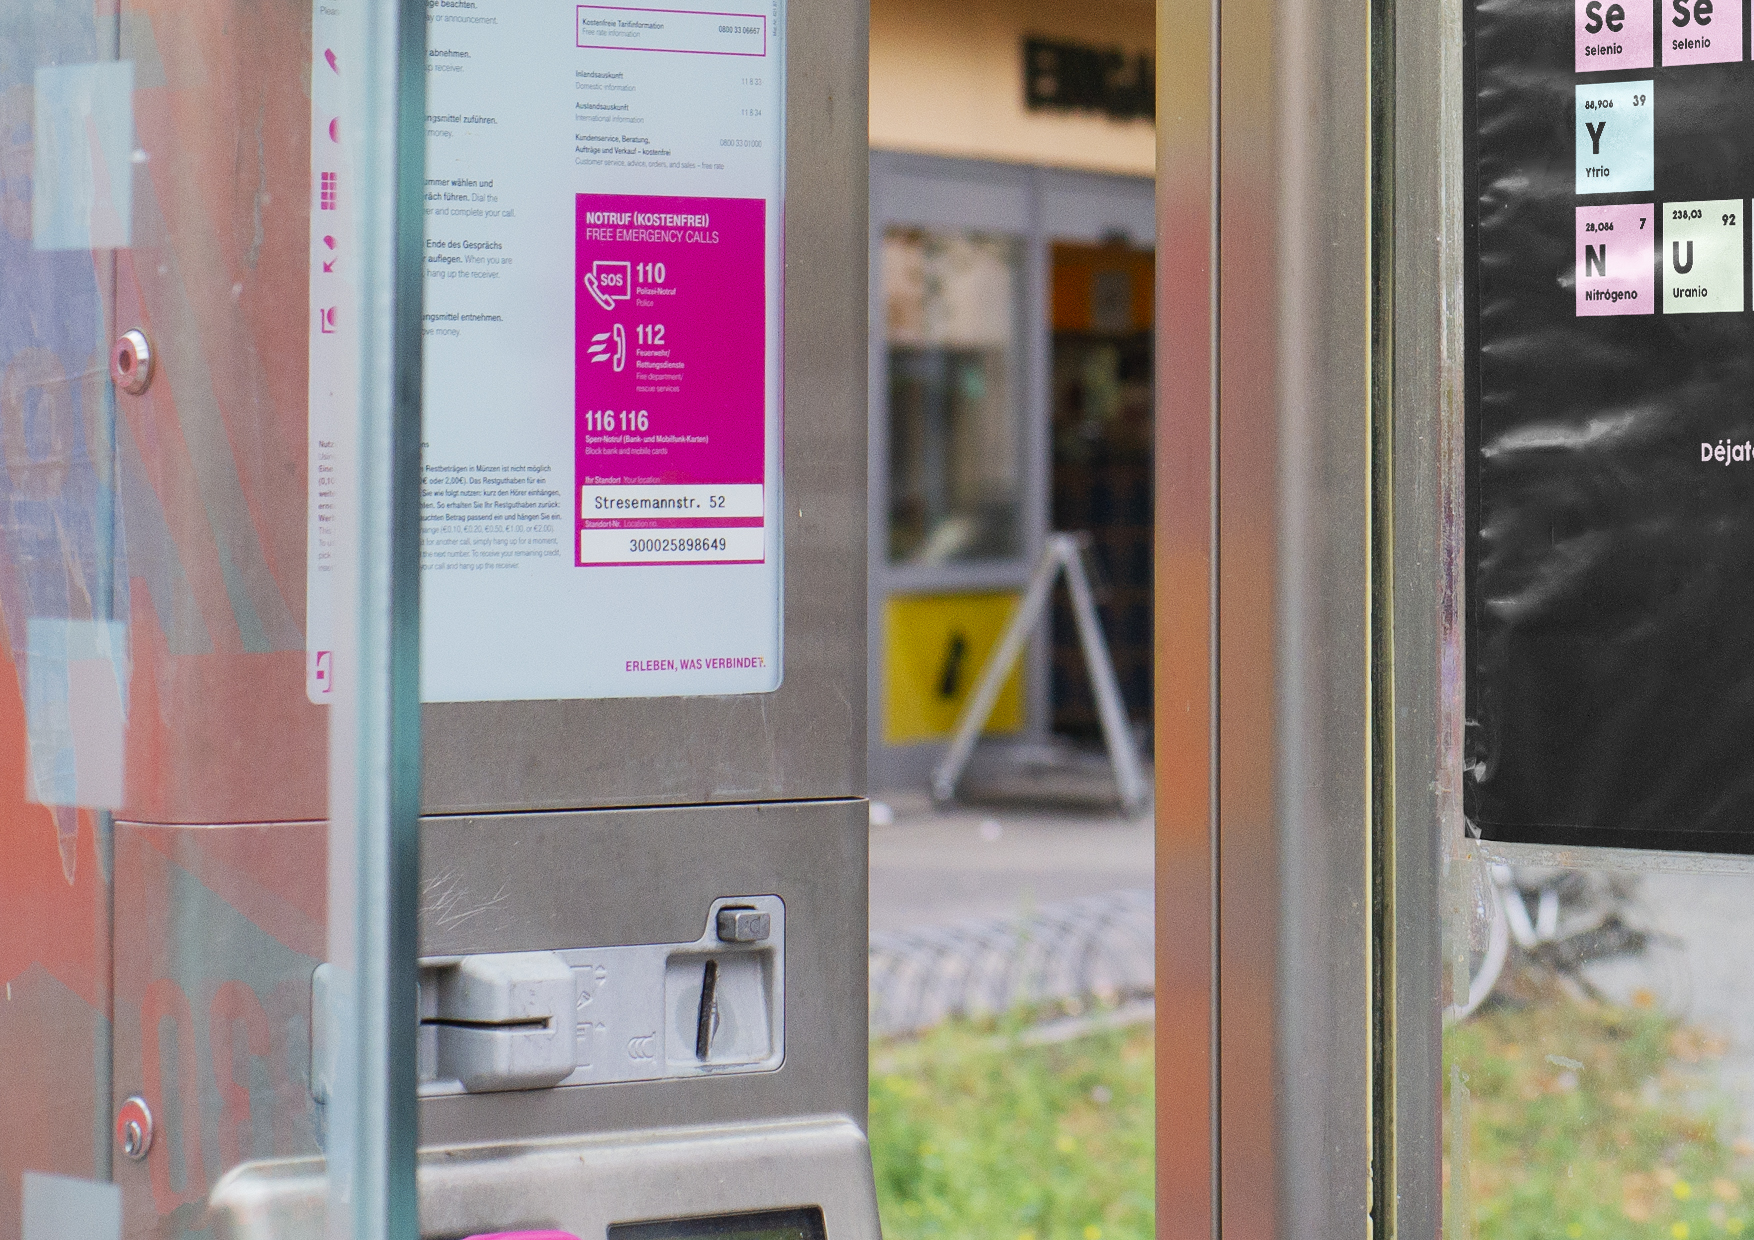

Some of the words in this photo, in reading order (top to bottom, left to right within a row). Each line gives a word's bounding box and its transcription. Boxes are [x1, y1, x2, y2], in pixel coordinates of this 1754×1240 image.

[441, 0, 478, 9] beachten.
[1585, 1, 1625, 34] Se
[583, 19, 616, 27] Kostenfreie
[617, 20, 664, 30] Tarifinformation
[1673, 36, 1710, 50] Selenio
[429, 49, 471, 58] abnehmen.
[1585, 45, 1622, 56] Selenio
[1585, 100, 1613, 110] 88,906
[1633, 95, 1646, 106] 39
[575, 102, 629, 111] Auslandsauskunft
[464, 115, 498, 124] zuführen.
[1585, 122, 1606, 154] Y
[601, 147, 613, 155] und
[1586, 166, 1609, 177] Ytrio
[451, 178, 478, 187] wählen
[479, 179, 493, 188] und
[444, 192, 470, 202] führen.
[586, 212, 632, 225] NOTRUF
[634, 211, 709, 228] (KOSTENFREI)
[1673, 209, 1702, 220] 238,03
[1722, 214, 1735, 225] 92
[1586, 222, 1613, 233] 28,086
[586, 228, 613, 241] FREE
[616, 229, 683, 243] EMERGENCY
[685, 231, 719, 243] CALLS
[426, 239, 446, 248] Ende
[448, 240, 461, 248] des
[462, 240, 502, 250] Gesprächs
[428, 254, 462, 264] auflegen.
[1585, 244, 1605, 276] N
[1673, 241, 1693, 274] U
[637, 262, 666, 283] 110
[601, 274, 623, 286] SOS
[1586, 289, 1637, 303] Nitrógeno
[1673, 288, 1707, 298] Uranio
[460, 313, 503, 322] entnehmen.
[637, 324, 665, 345] 112
[586, 410, 615, 431] 116
[620, 410, 648, 431] 116
[643, 435, 655, 443] und
[595, 496, 701, 509] Stresemannstr.
[709, 496, 726, 508] 52
[630, 538, 726, 552] 300025898649
[626, 660, 678, 672] ERLEBEN,
[680, 659, 702, 670] WAS
